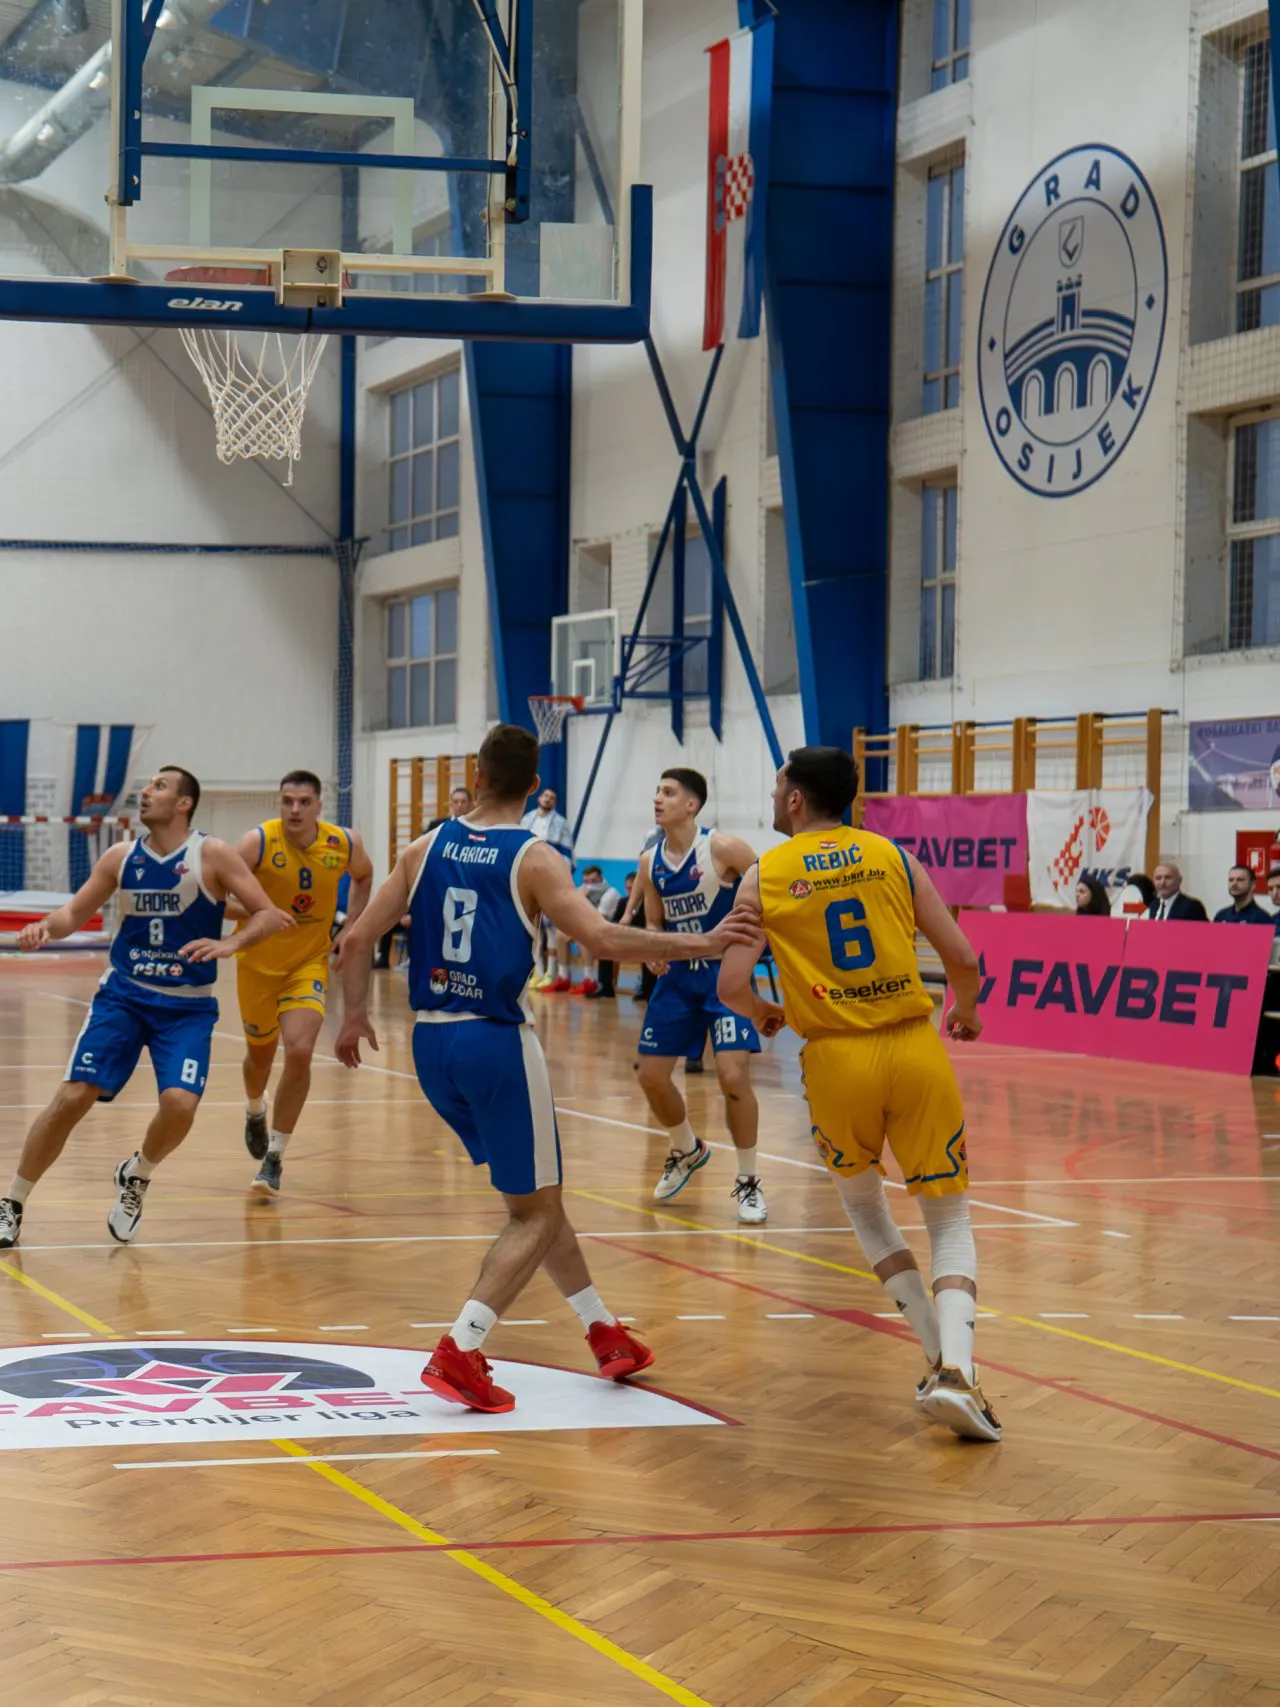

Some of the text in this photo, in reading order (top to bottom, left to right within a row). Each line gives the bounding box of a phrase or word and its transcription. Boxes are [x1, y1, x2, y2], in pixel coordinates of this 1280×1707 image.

[1008, 159, 1140, 255] GRAD
[167, 297, 244, 312] elan
[996, 373, 1143, 485] OSIJEK
[442, 841, 500, 865] KLARICA
[803, 843, 863, 872] REBIĆ
[298, 866, 313, 890] 8
[133, 892, 180, 912] ZADAR
[665, 892, 708, 918] ZADAR
[825, 898, 876, 971] 6
[1007, 958, 1248, 1029] FAVBET
[65, 1409, 422, 1429] Premijer liga
